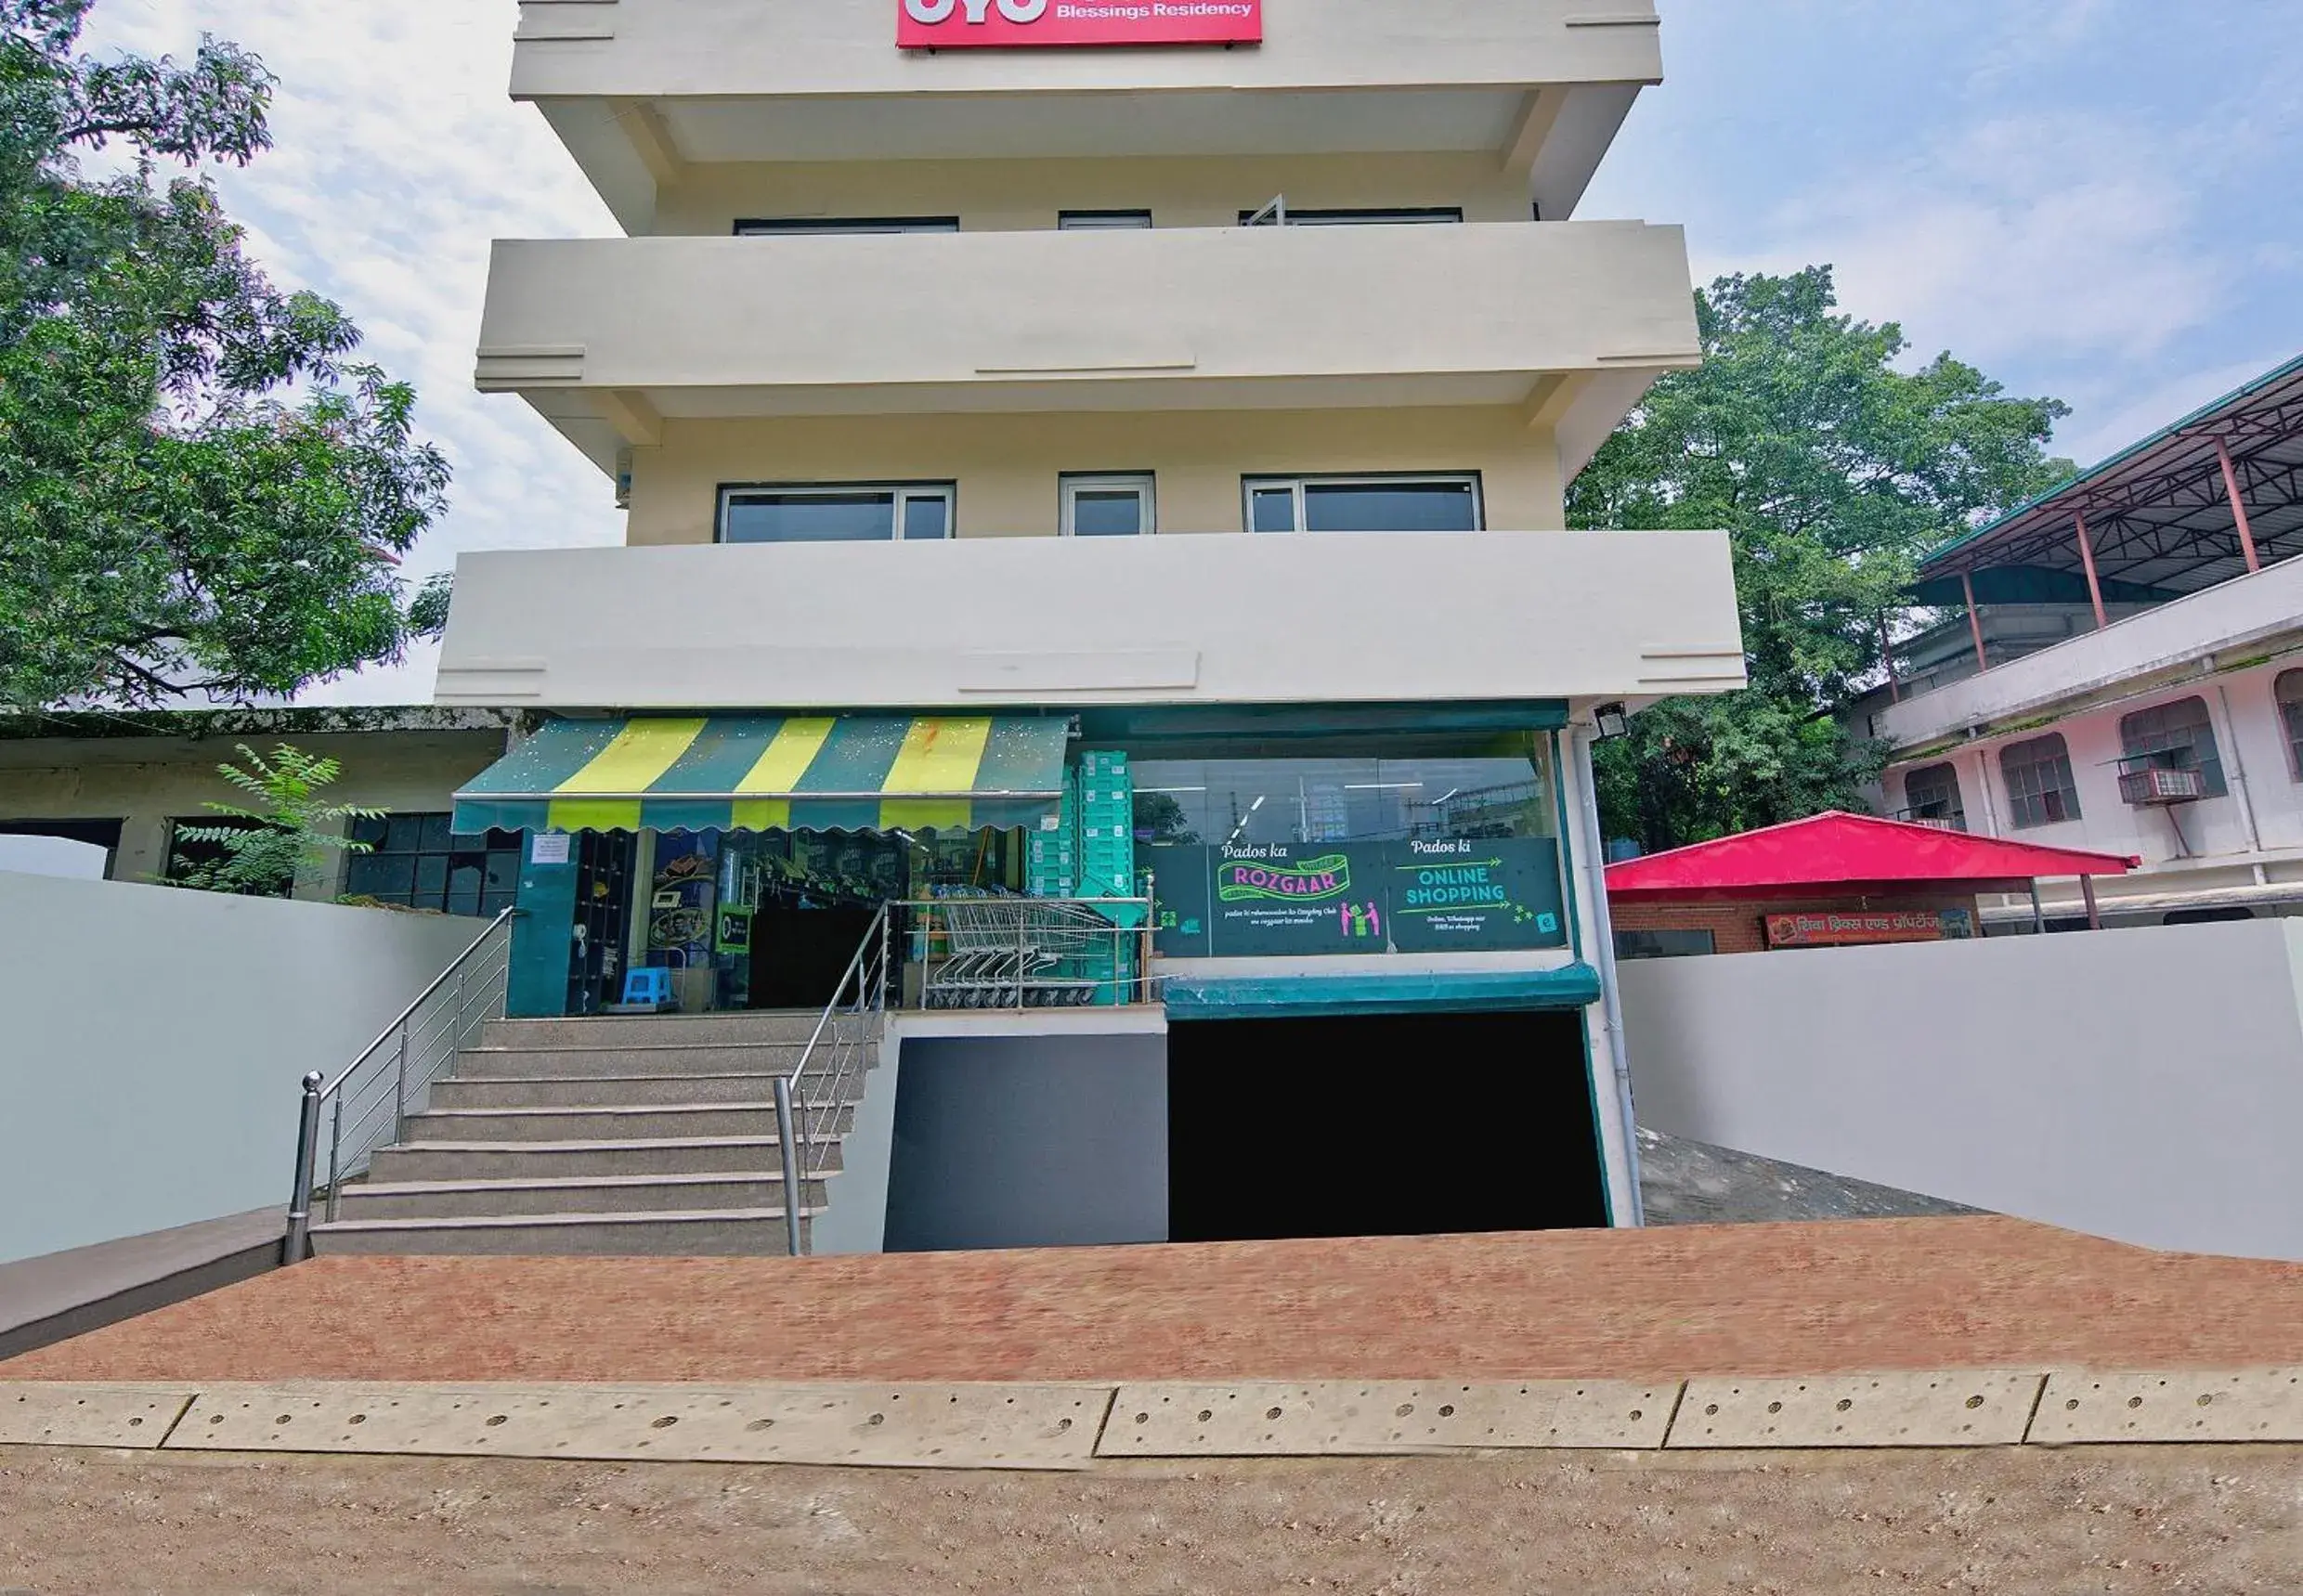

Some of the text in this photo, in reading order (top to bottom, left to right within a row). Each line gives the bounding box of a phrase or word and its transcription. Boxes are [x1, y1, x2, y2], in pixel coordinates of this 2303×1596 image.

[1056, 2, 1253, 19] Blessings Residency
[1221, 842, 1287, 859] Pados ka
[1411, 839, 1471, 853] Pados ki
[1234, 866, 1336, 894] ROZGAAR
[1418, 868, 1490, 886] ONLINE
[1406, 885, 1504, 904] SHOPPING
